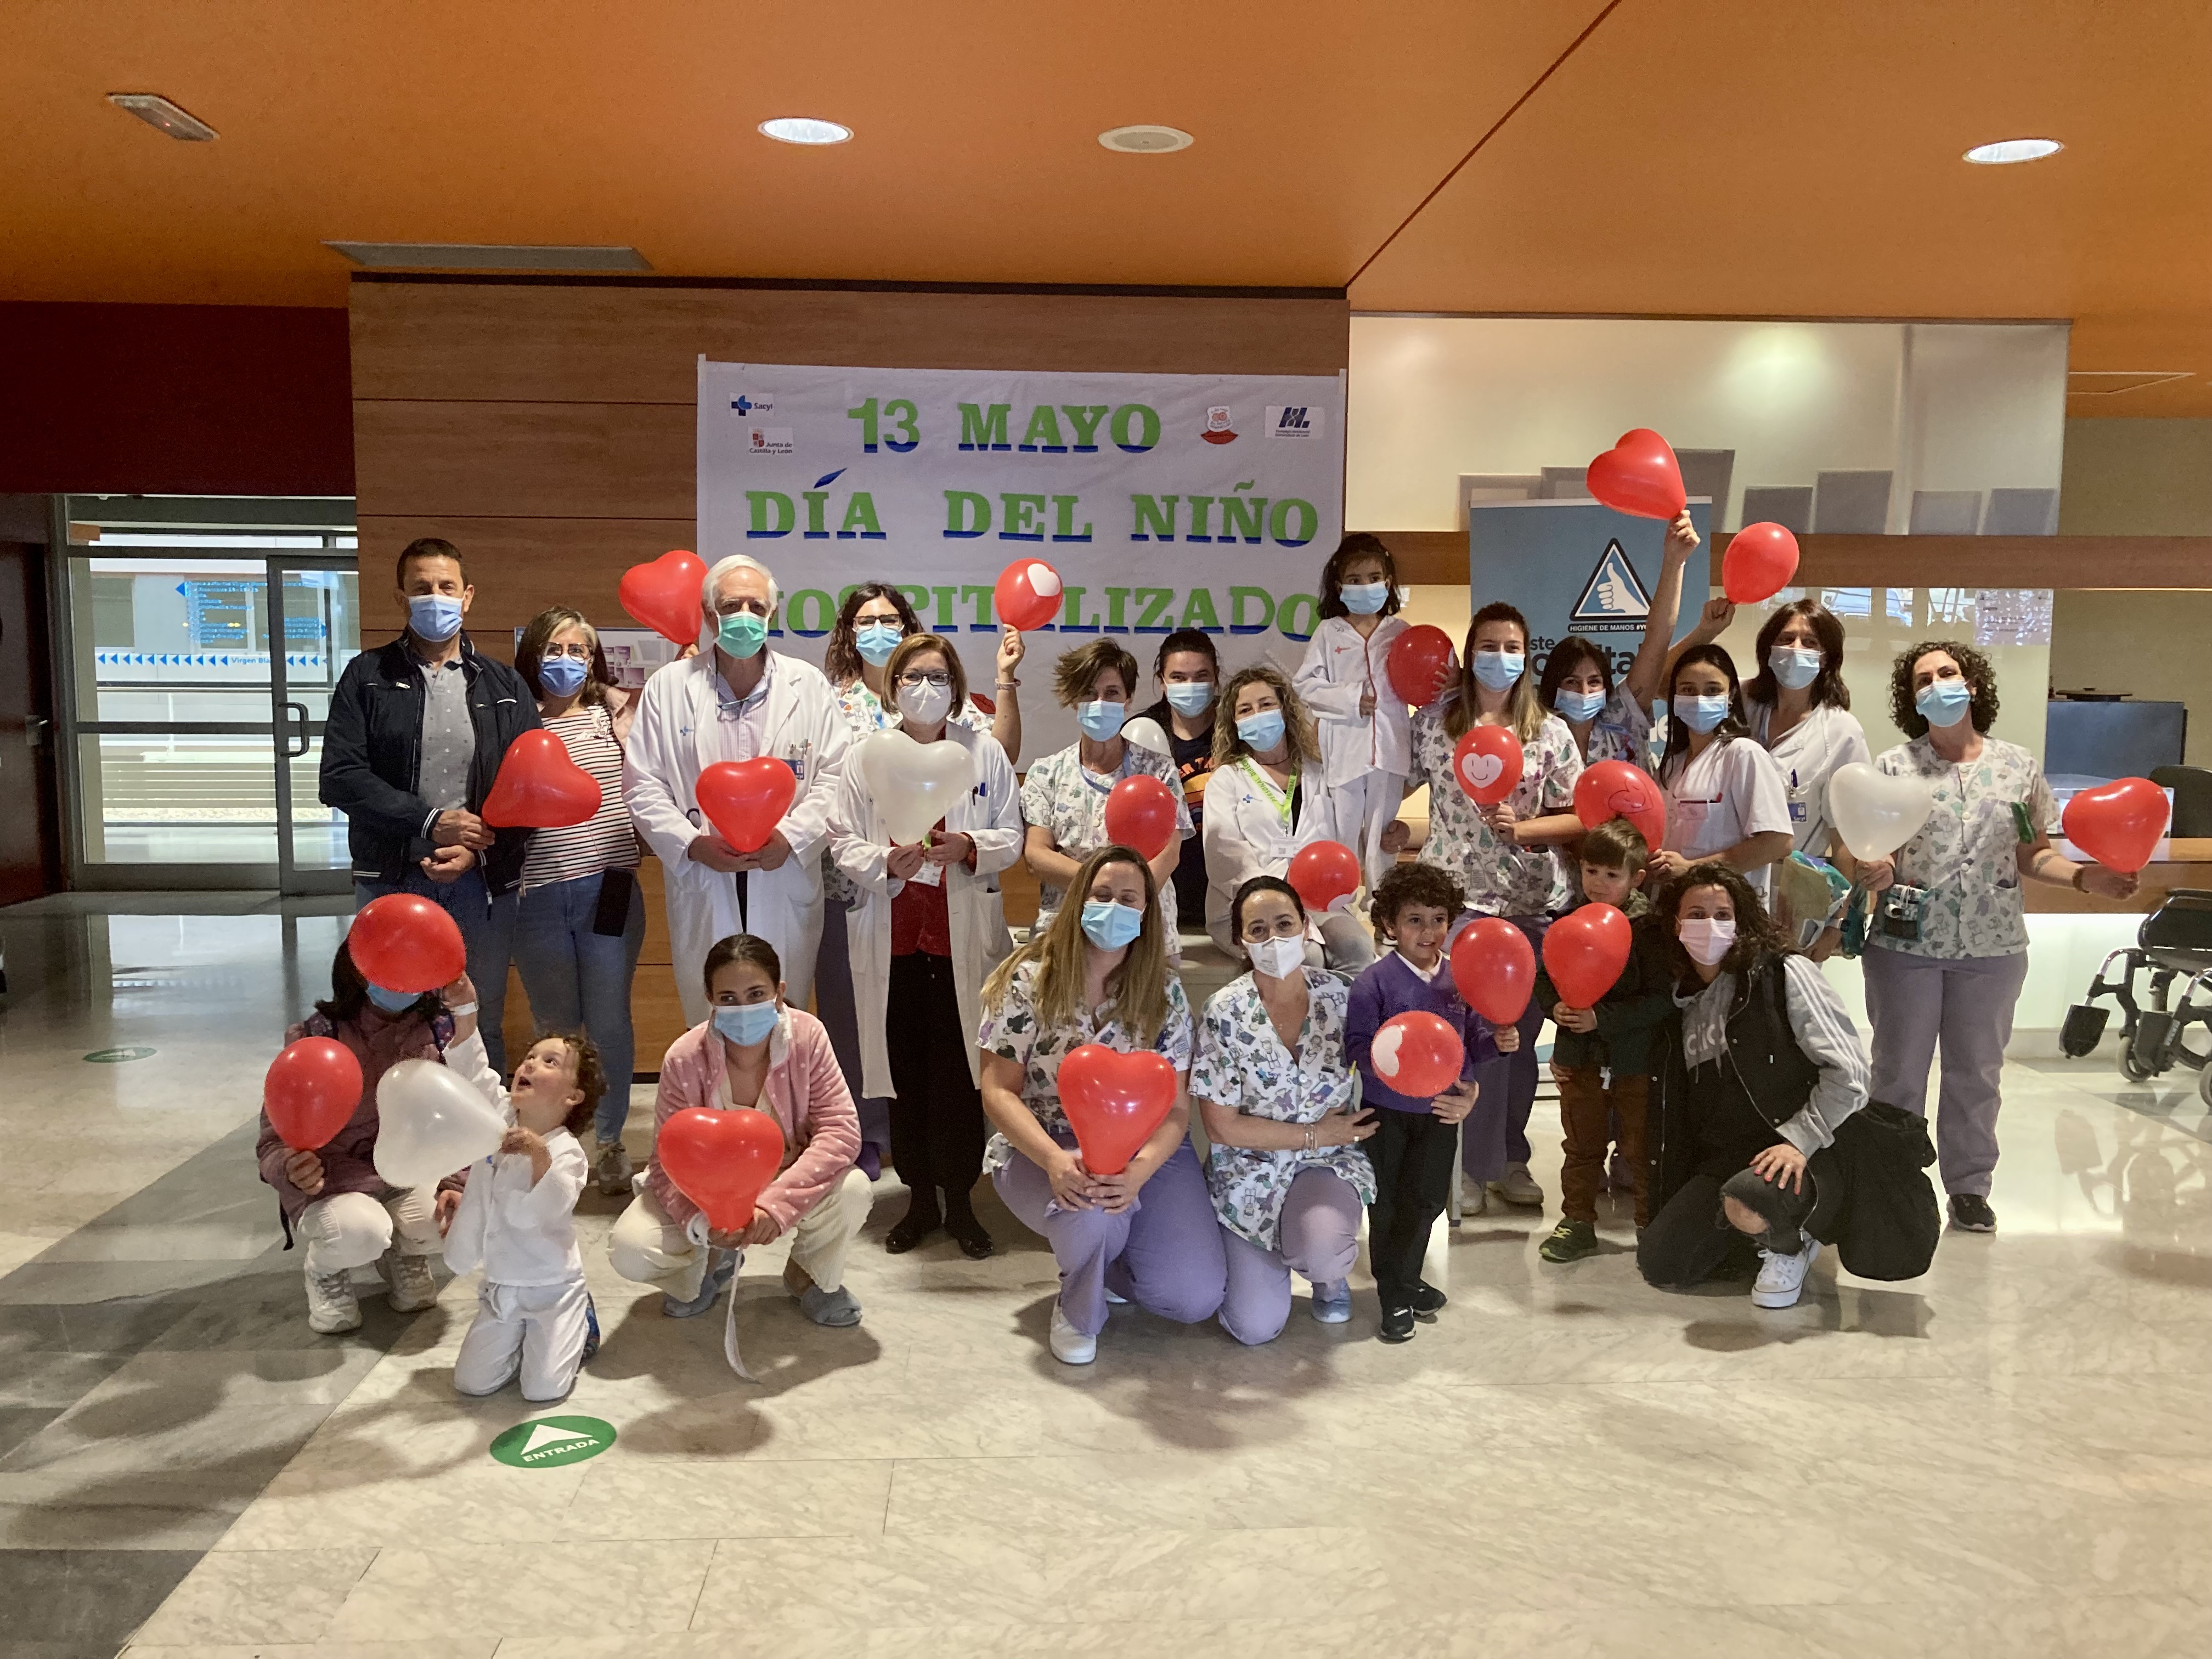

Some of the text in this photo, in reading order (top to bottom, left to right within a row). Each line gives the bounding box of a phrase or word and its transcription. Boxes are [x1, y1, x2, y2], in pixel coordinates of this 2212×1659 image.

[754, 403, 773, 411] Sacyl
[847, 398, 1161, 454] 13 MAYO
[746, 467, 1318, 548] DÍA DEL NIÑO
[1530, 636, 1555, 650] ste
[1256, 777, 1278, 802] PERSONAL
[523, 1439, 600, 1462] ENTRADA
